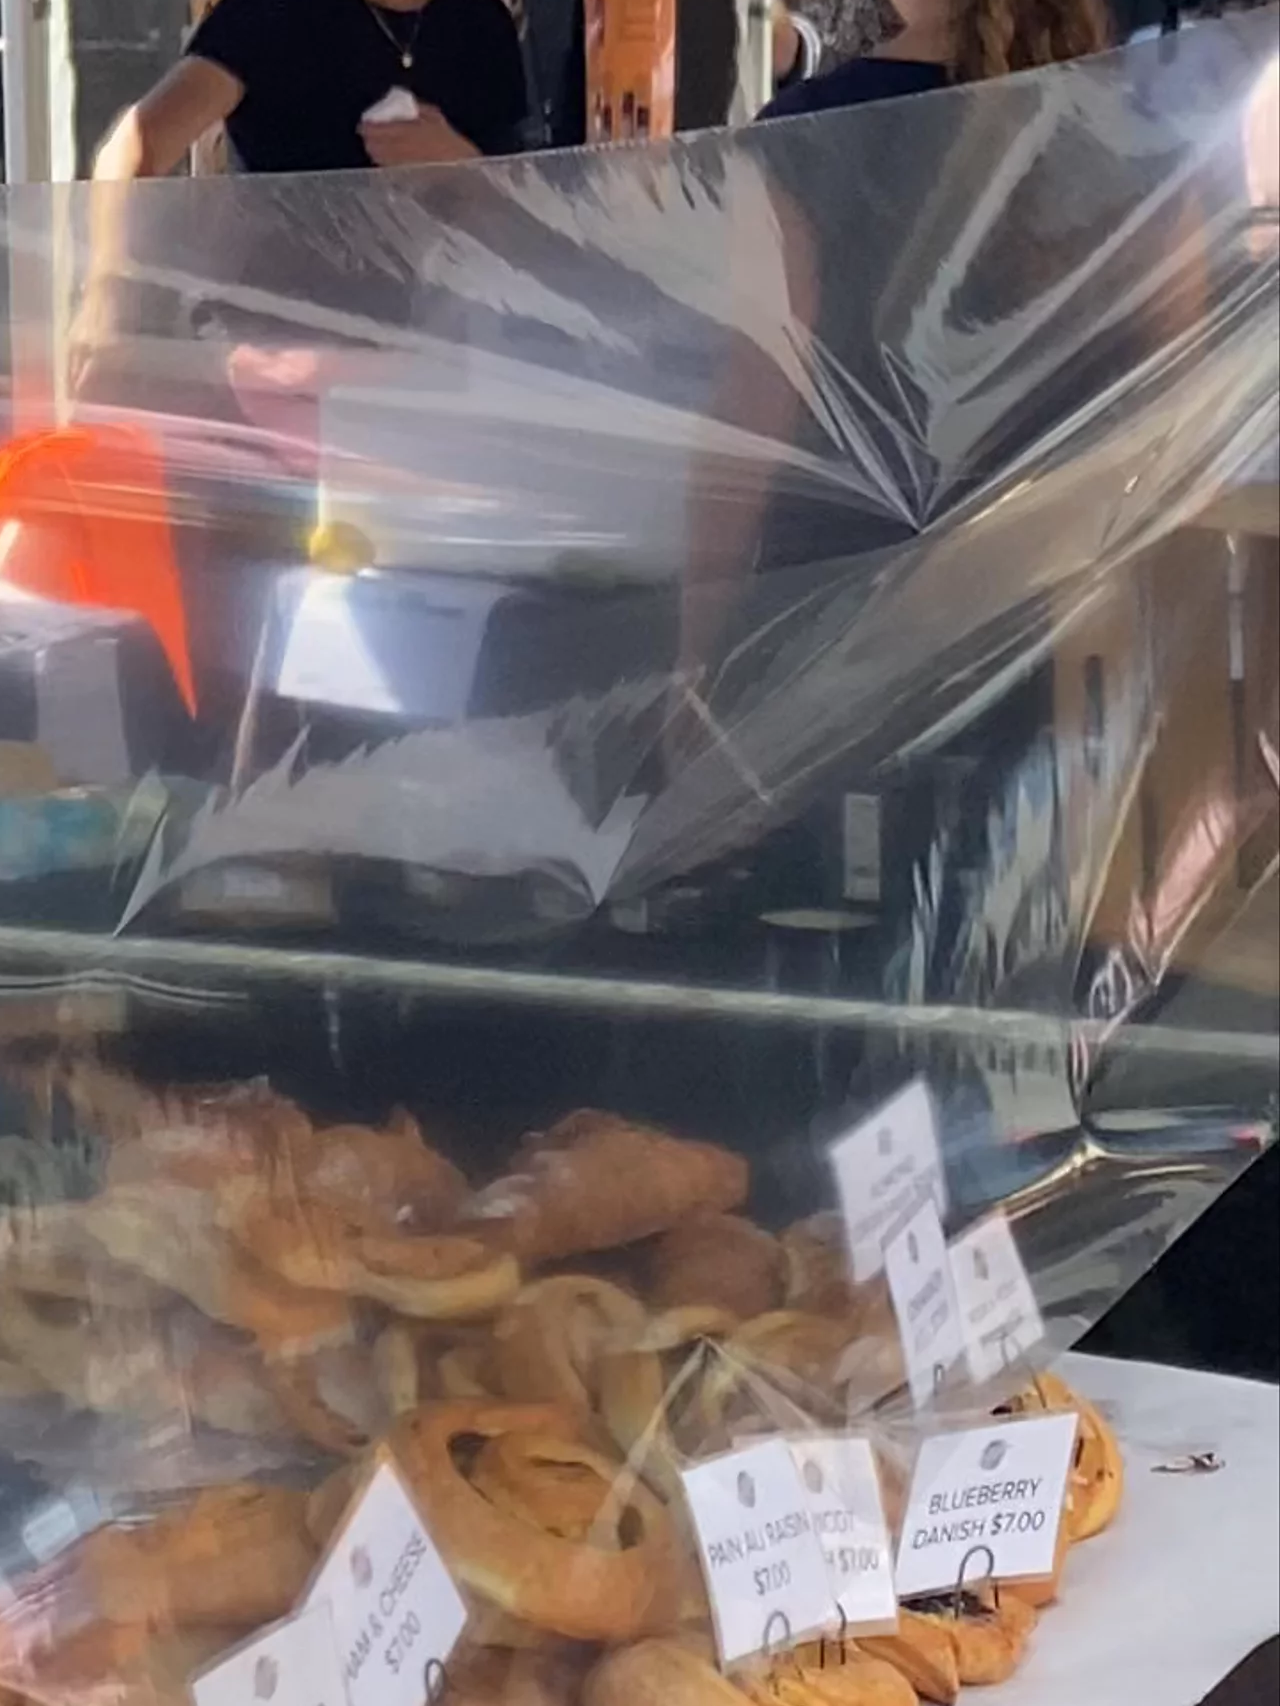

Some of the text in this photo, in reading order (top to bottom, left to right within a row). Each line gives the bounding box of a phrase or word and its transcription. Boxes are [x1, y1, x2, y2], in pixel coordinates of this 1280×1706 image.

[928, 1477, 1043, 1516] BLUEBERRY
[912, 1510, 1046, 1550] DANISH $7.00
